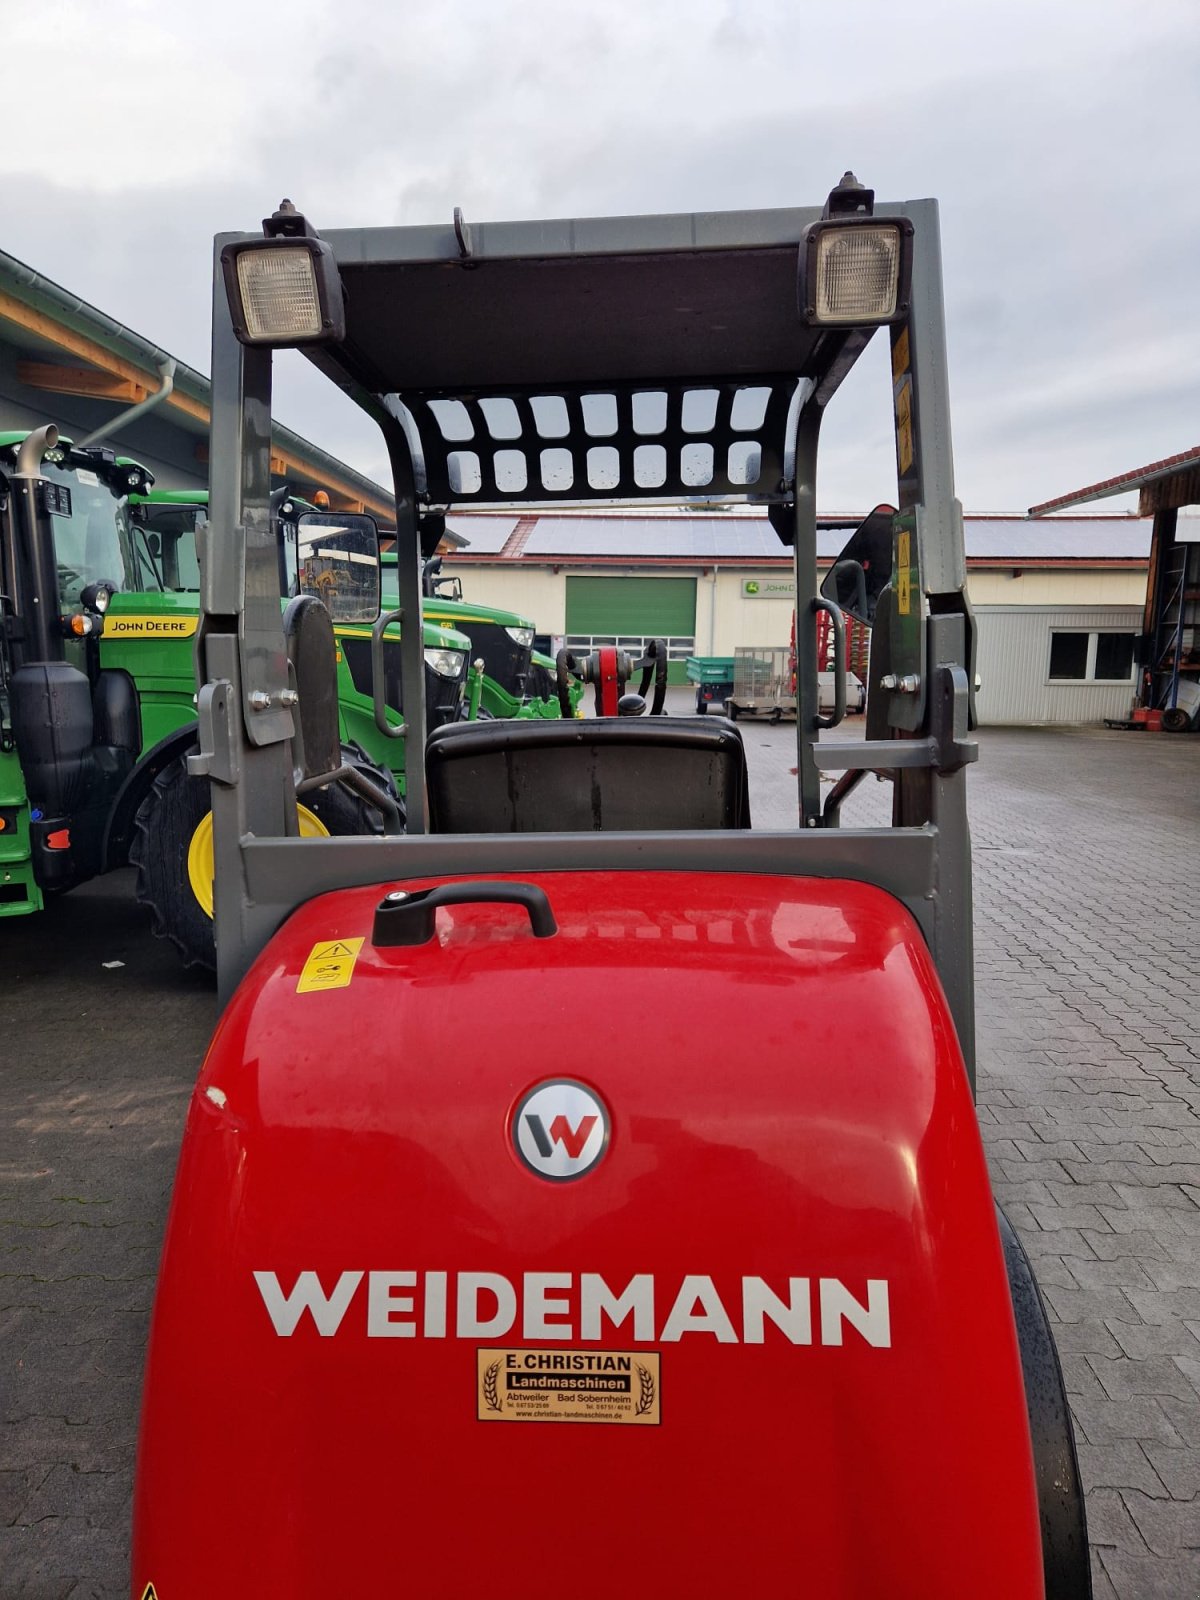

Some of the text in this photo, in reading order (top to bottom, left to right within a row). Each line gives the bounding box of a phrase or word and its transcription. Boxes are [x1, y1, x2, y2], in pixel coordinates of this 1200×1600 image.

[765, 584, 788, 592] JOHN
[112, 622, 186, 631] JOHN DEERE
[525, 1114, 599, 1159] W
[252, 1270, 891, 1348] WEIDEMANN
[524, 1354, 631, 1371] CHRISTIAN
[512, 1376, 626, 1390] Landmaschinen
[506, 1393, 550, 1402] Abtweiler
[557, 1394, 631, 1404] Bad Sobernheim
[516, 1410, 623, 1420] www.christian-landmaschinen.de
